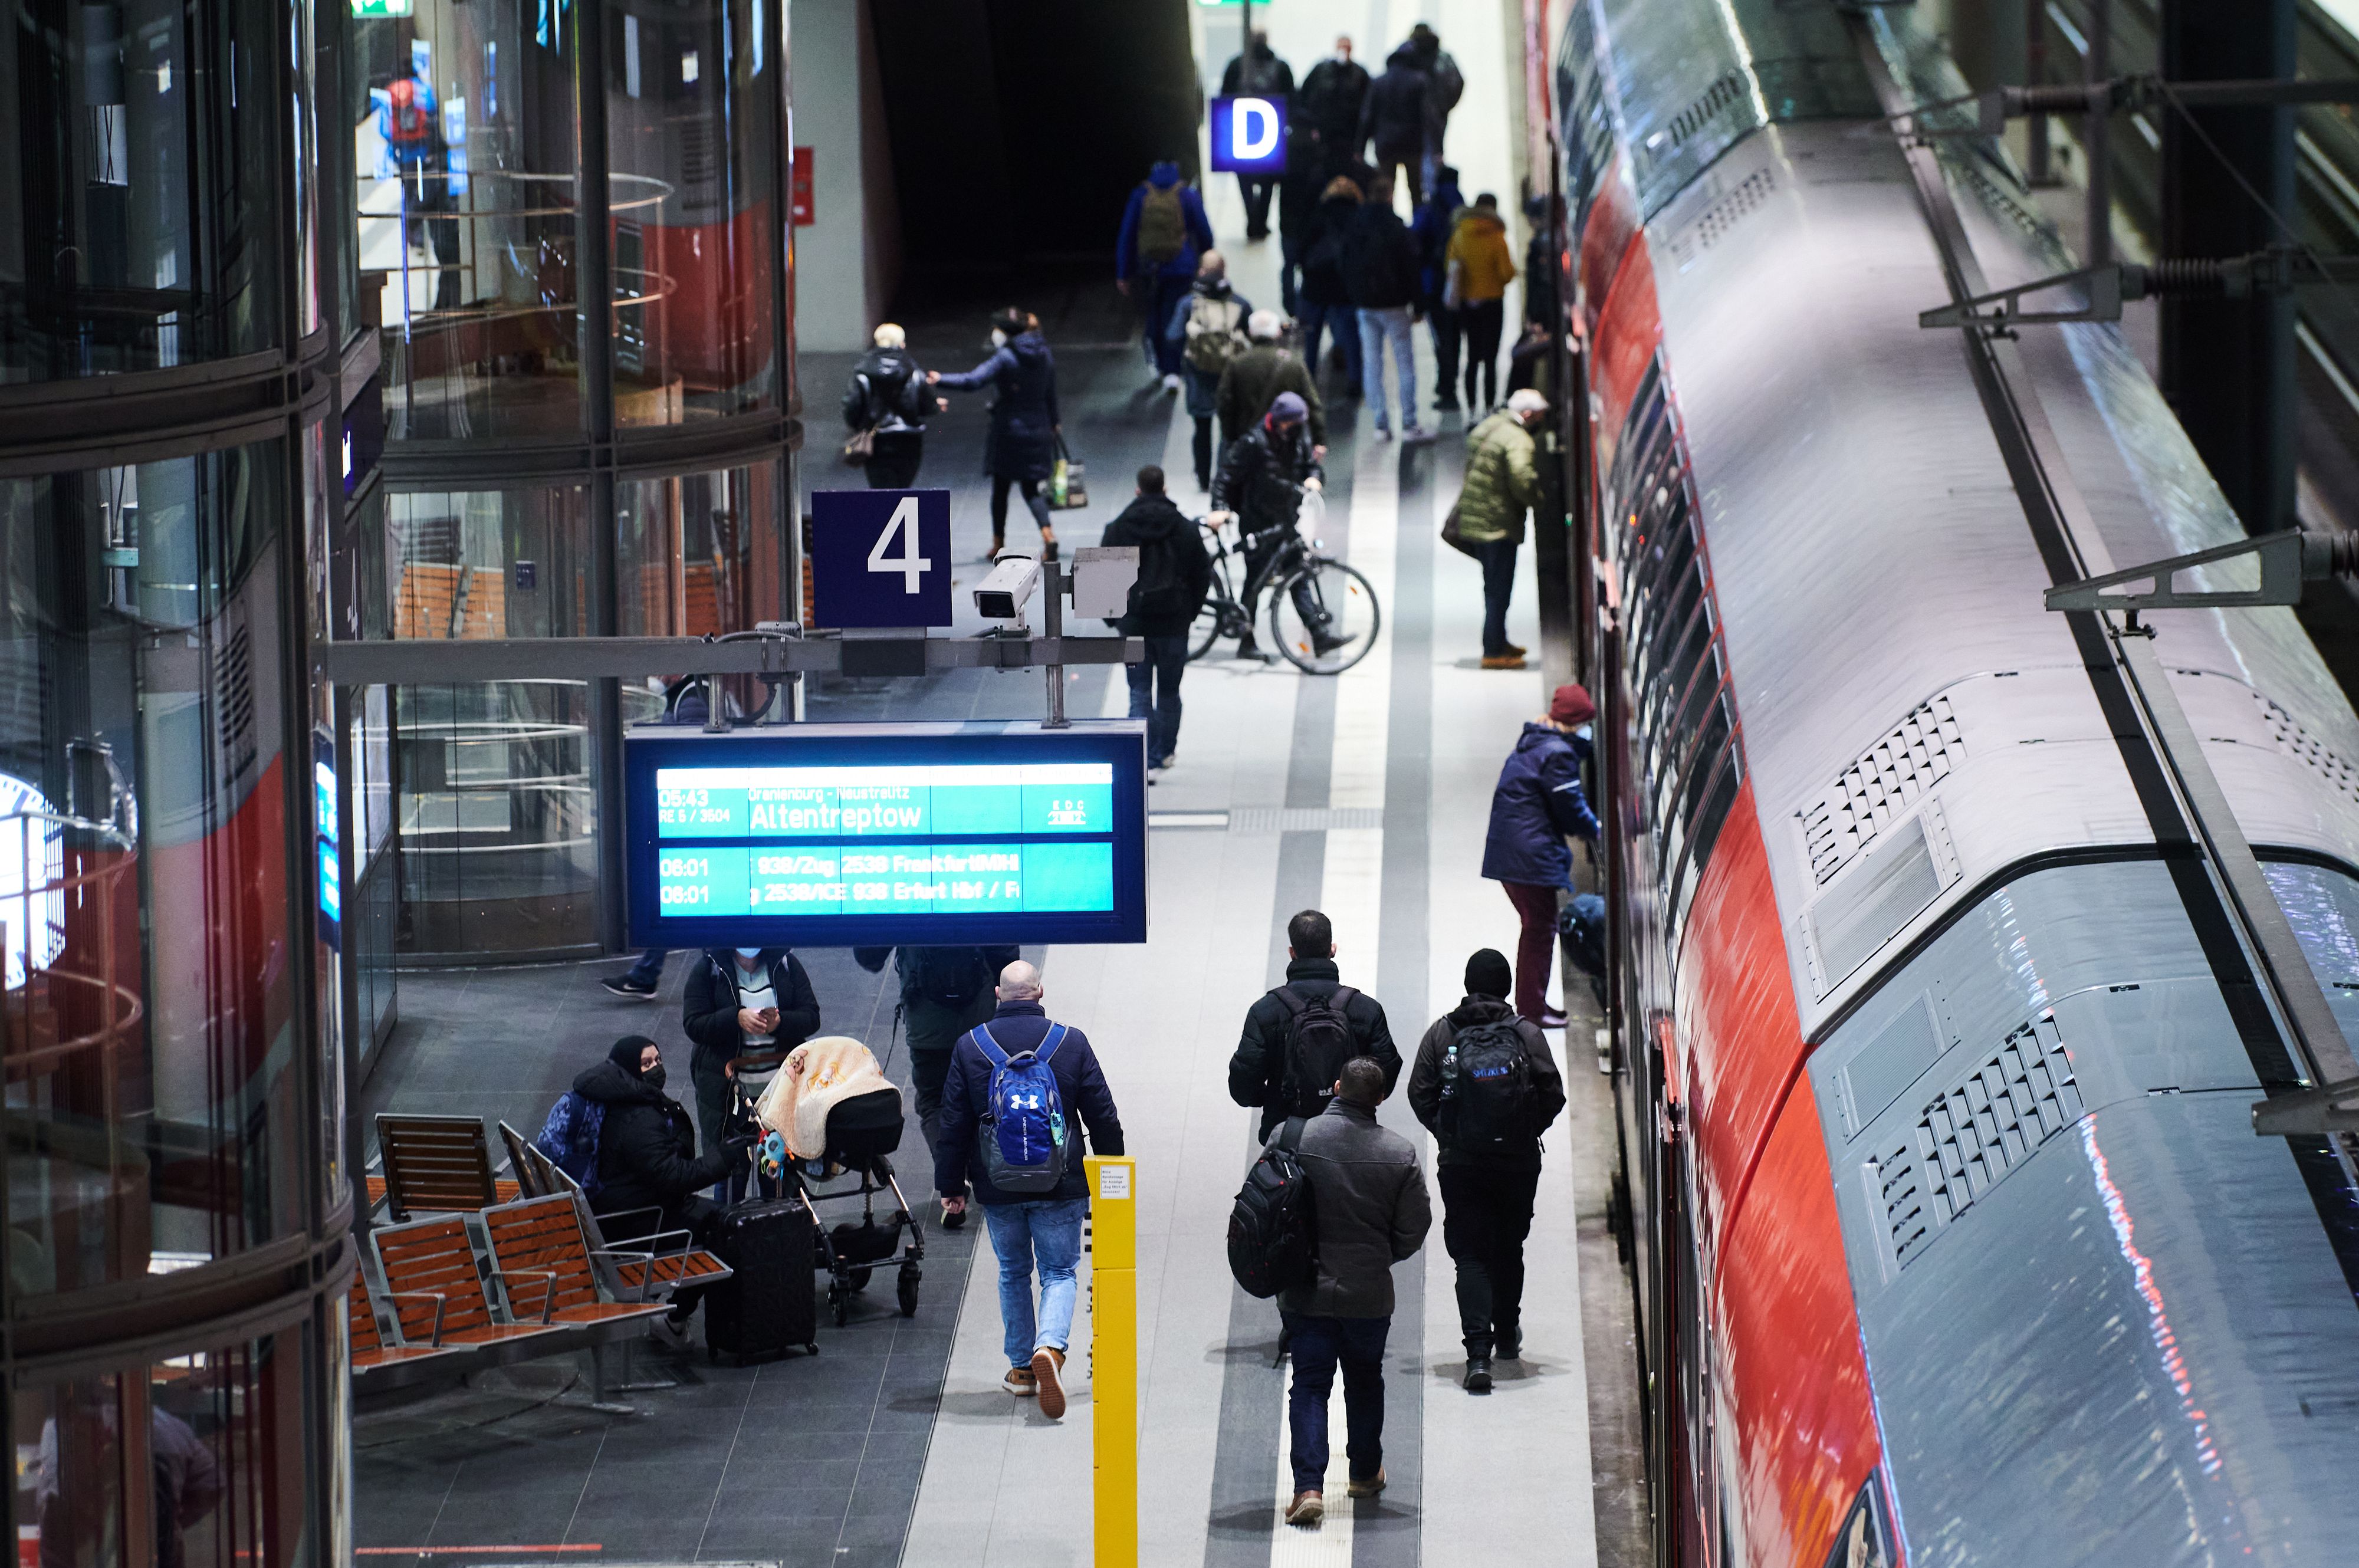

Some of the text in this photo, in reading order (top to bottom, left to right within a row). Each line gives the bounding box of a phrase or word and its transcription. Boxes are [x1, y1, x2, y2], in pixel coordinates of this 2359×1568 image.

[1233, 97, 1279, 159] D
[868, 497, 931, 594] 4
[658, 789, 708, 807] 05:43
[659, 808, 675, 823] RE
[750, 803, 921, 834] Altentreptow
[660, 858, 708, 877] 06:01
[660, 886, 708, 904] 06:01
[893, 881, 947, 900] Erfurt
[952, 880, 984, 899] Hbf
